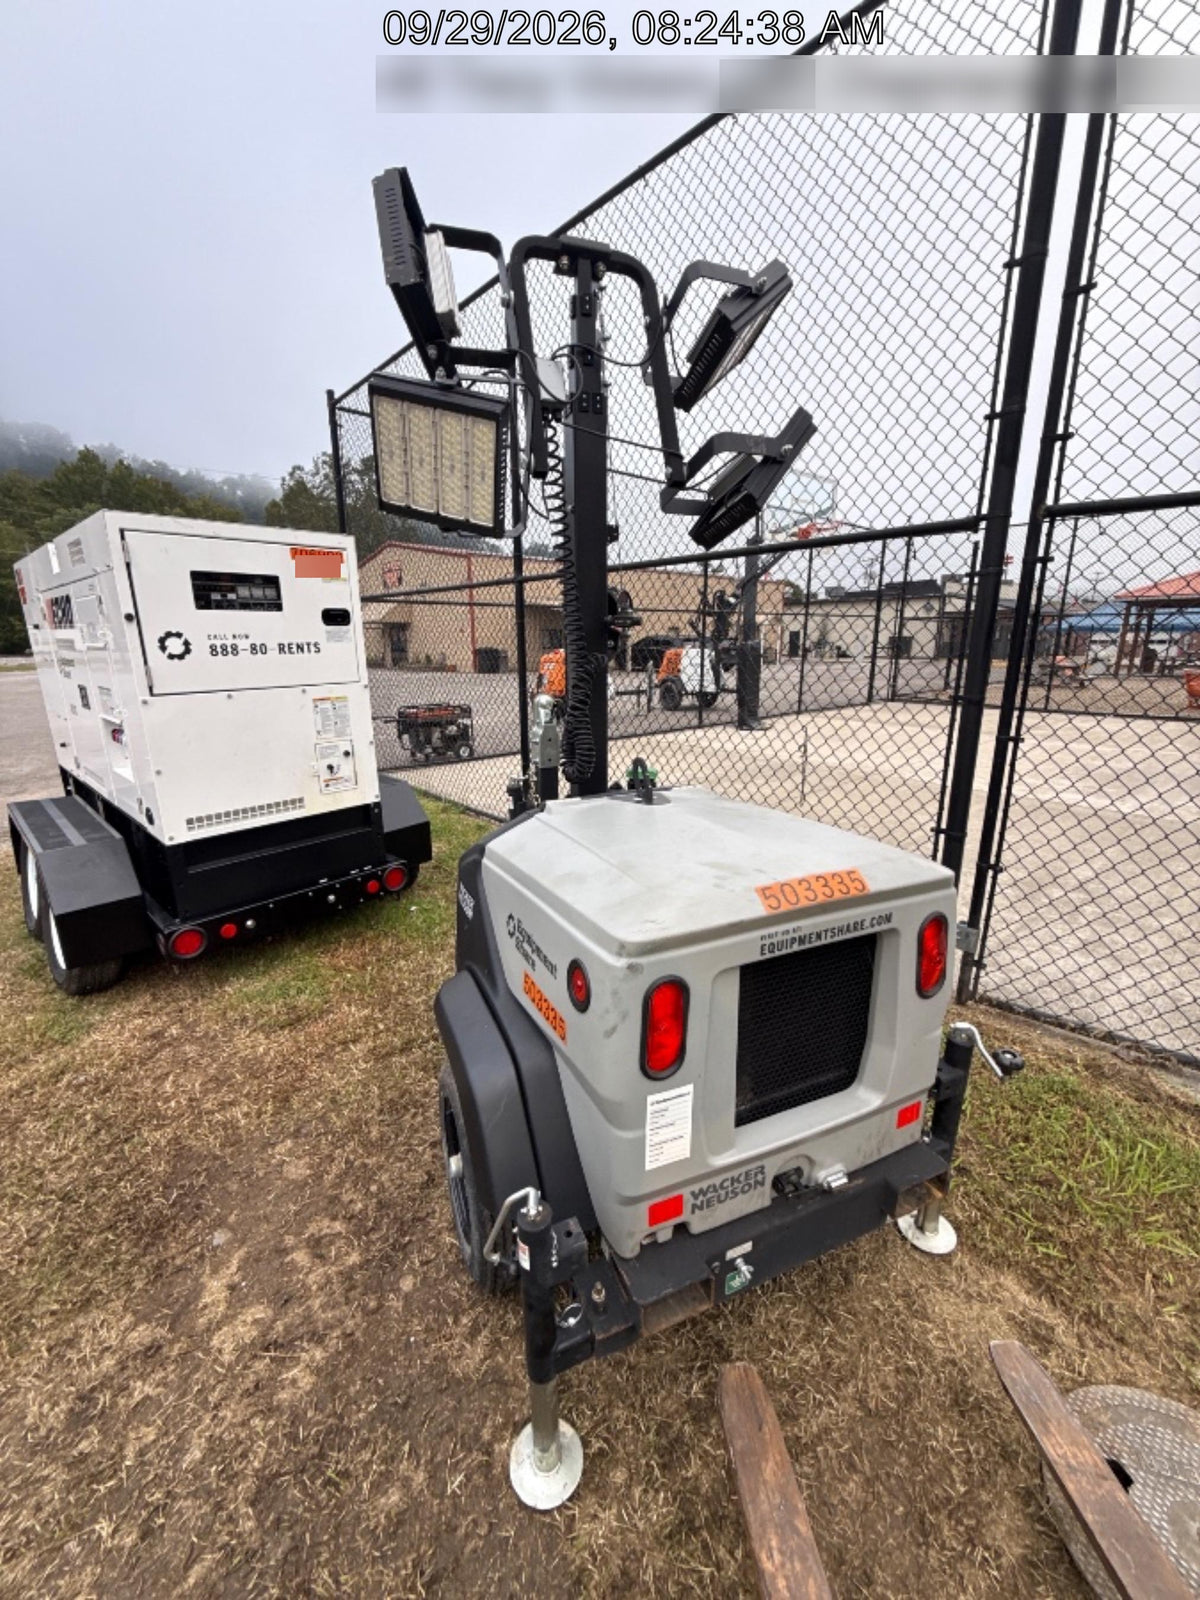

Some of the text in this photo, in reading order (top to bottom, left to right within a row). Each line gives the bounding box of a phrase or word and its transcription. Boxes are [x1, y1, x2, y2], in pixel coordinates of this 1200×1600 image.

[760, 870, 867, 911] 503335
[760, 911, 894, 957] EQUIPMENTSHARE.COM
[524, 973, 567, 1042] 503335
[689, 1164, 767, 1201] WACKER
[690, 1176, 767, 1216] NEUSON
